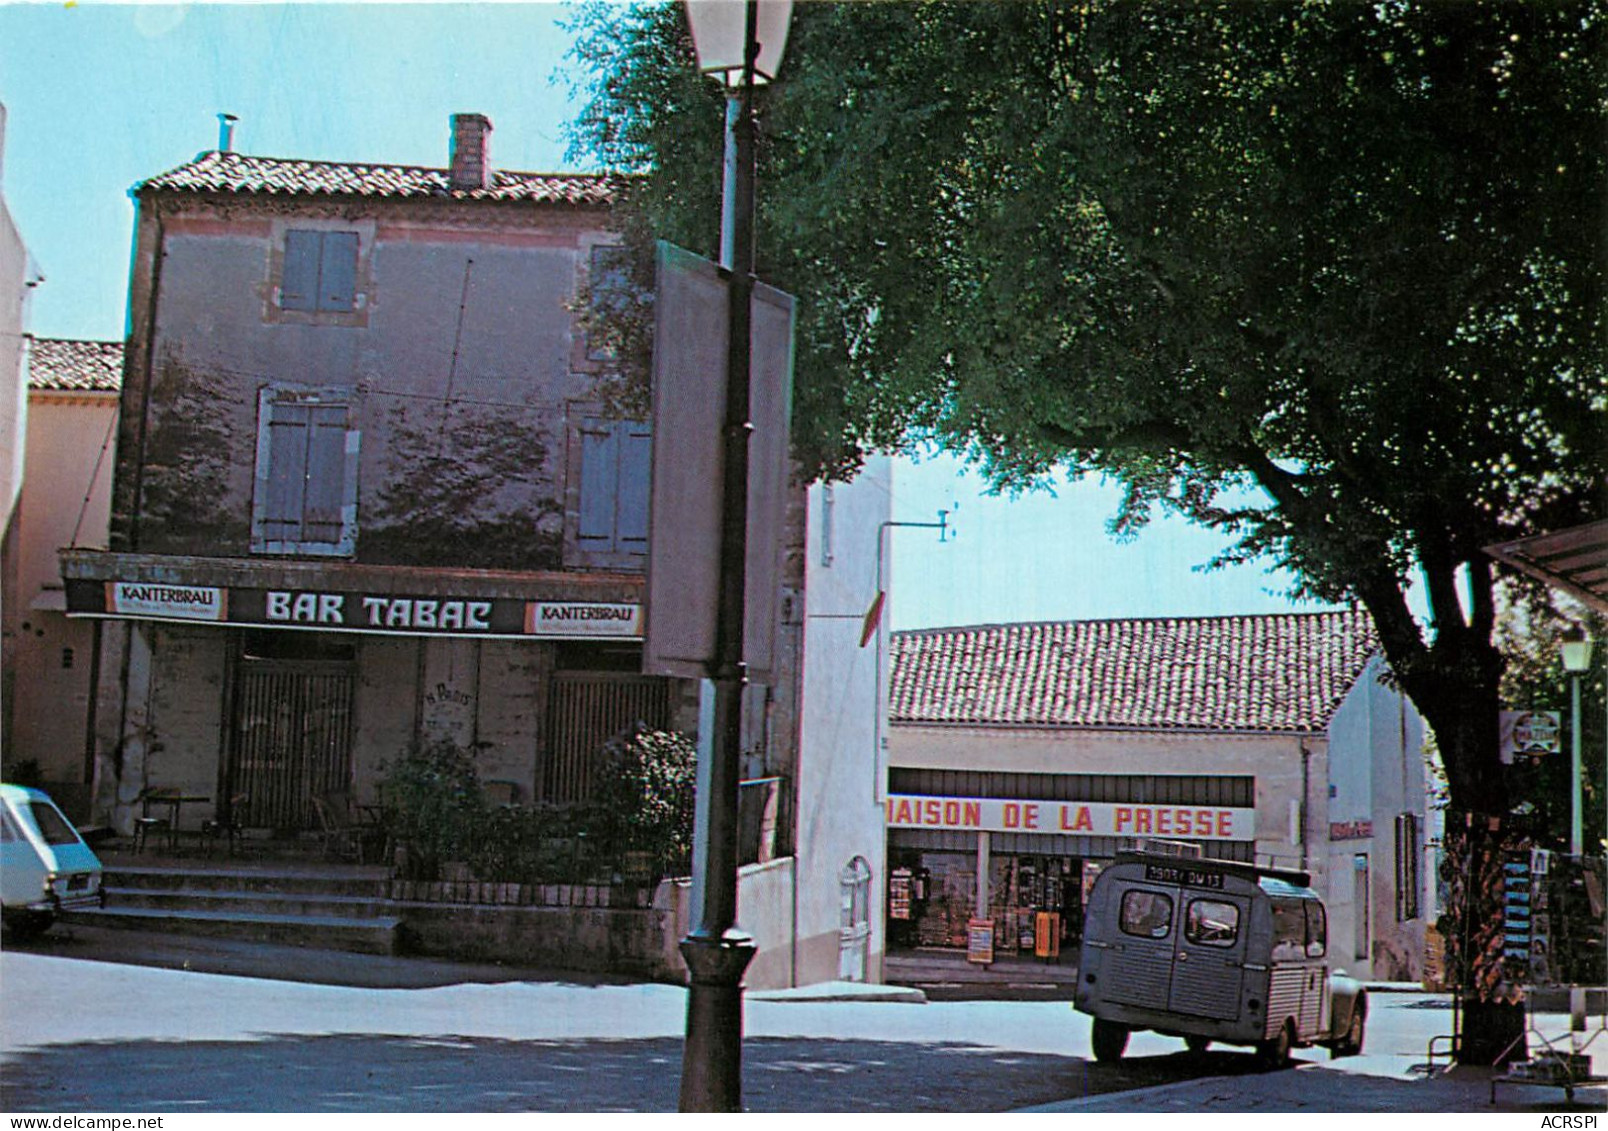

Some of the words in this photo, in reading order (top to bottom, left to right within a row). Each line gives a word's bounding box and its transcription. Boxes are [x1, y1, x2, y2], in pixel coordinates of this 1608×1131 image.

[266, 591, 343, 624] BAR
[362, 597, 491, 631] TABAC
[1002, 802, 1039, 830] DE
[1060, 805, 1093, 832] LA
[1114, 807, 1233, 837] PRESSE
